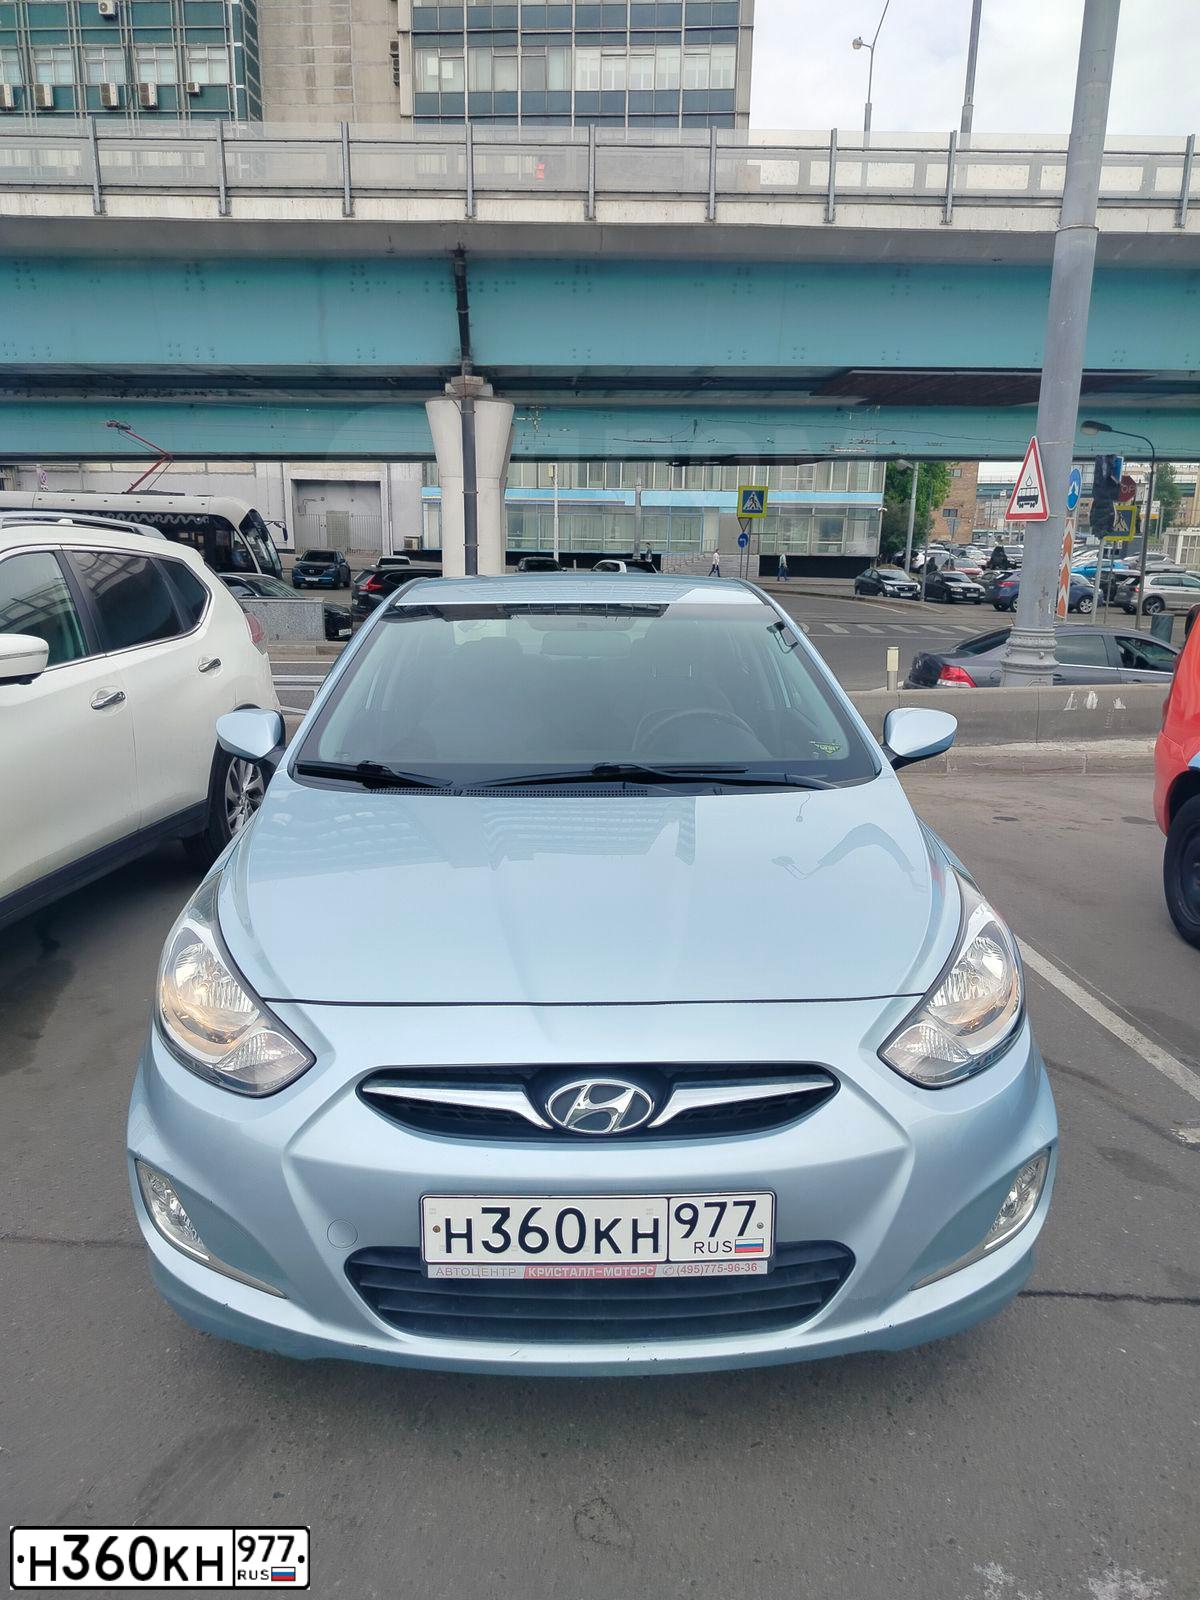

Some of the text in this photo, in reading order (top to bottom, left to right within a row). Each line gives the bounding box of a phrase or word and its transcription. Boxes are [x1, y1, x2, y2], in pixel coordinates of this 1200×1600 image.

[445, 1199, 757, 1255] Н360КН 977
[693, 1239, 732, 1254] RUS
[435, 1262, 758, 1278] АВТОЦЕНТР КРИСТАЛЛ-МОТОРС (495)775-96-36
